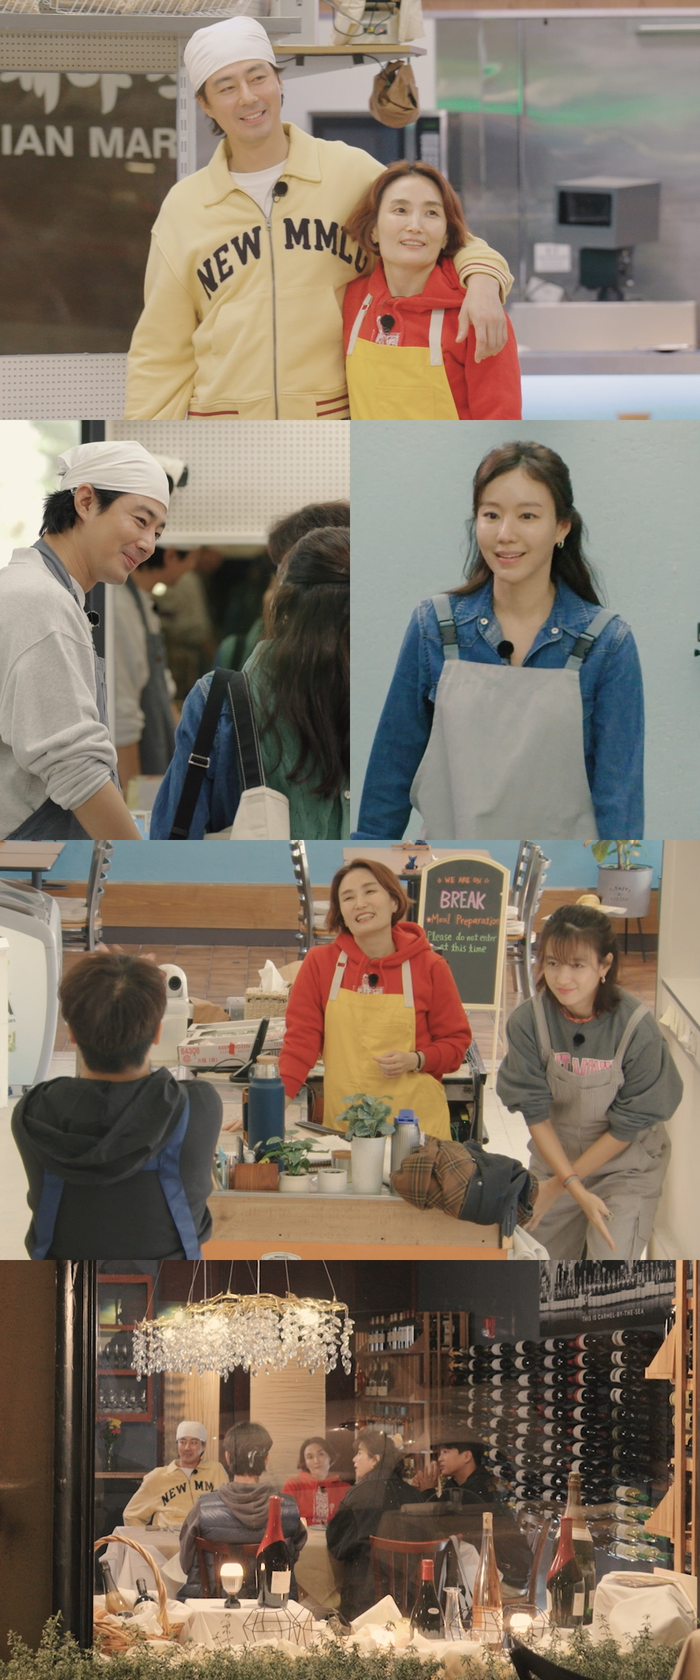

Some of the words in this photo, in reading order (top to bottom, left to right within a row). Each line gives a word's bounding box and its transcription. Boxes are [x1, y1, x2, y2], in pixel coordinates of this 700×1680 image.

[196, 225, 262, 300] NEW
[444, 876, 455, 884] WE
[458, 876, 470, 884] ARE
[473, 877, 482, 885] ON
[440, 890, 487, 910] BREAK
[431, 913, 451, 925] Meal
[456, 914, 500, 928] Preparation
[427, 930, 452, 942] Please
[456, 932, 465, 941] do
[466, 933, 479, 942] not
[480, 933, 497, 943] enter
[440, 943, 449, 951] at
[451, 942, 467, 953] this
[469, 943, 487, 954] time
[161, 1482, 187, 1507] NEW
